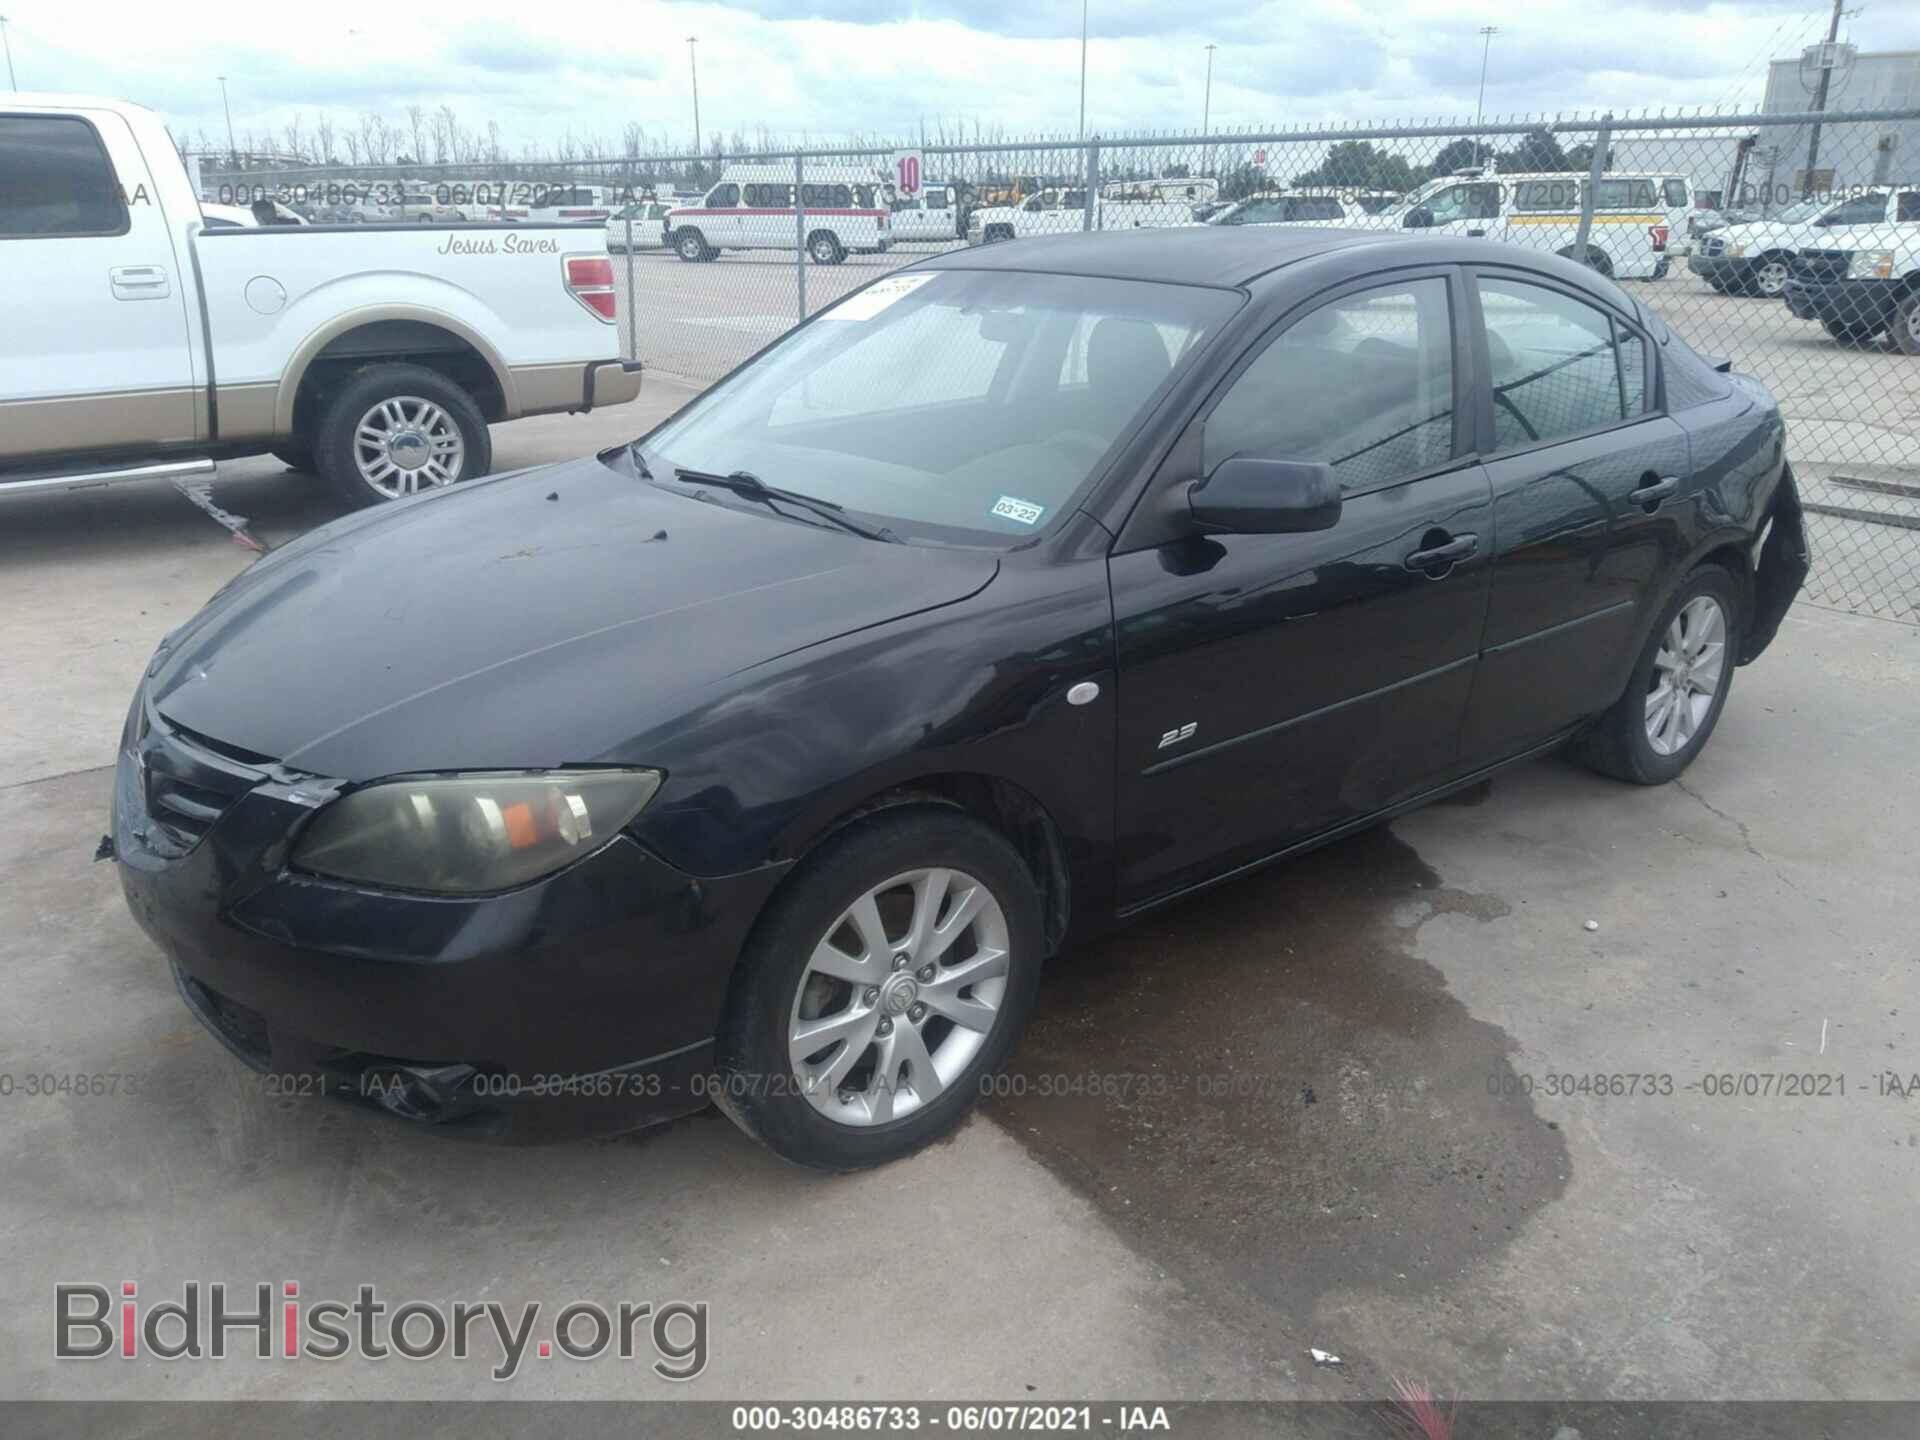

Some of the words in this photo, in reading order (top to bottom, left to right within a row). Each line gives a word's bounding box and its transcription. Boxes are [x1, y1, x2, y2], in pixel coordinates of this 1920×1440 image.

[897, 156, 919, 193] 10
[438, 233, 497, 255] Jesus
[502, 233, 560, 254] Saves
